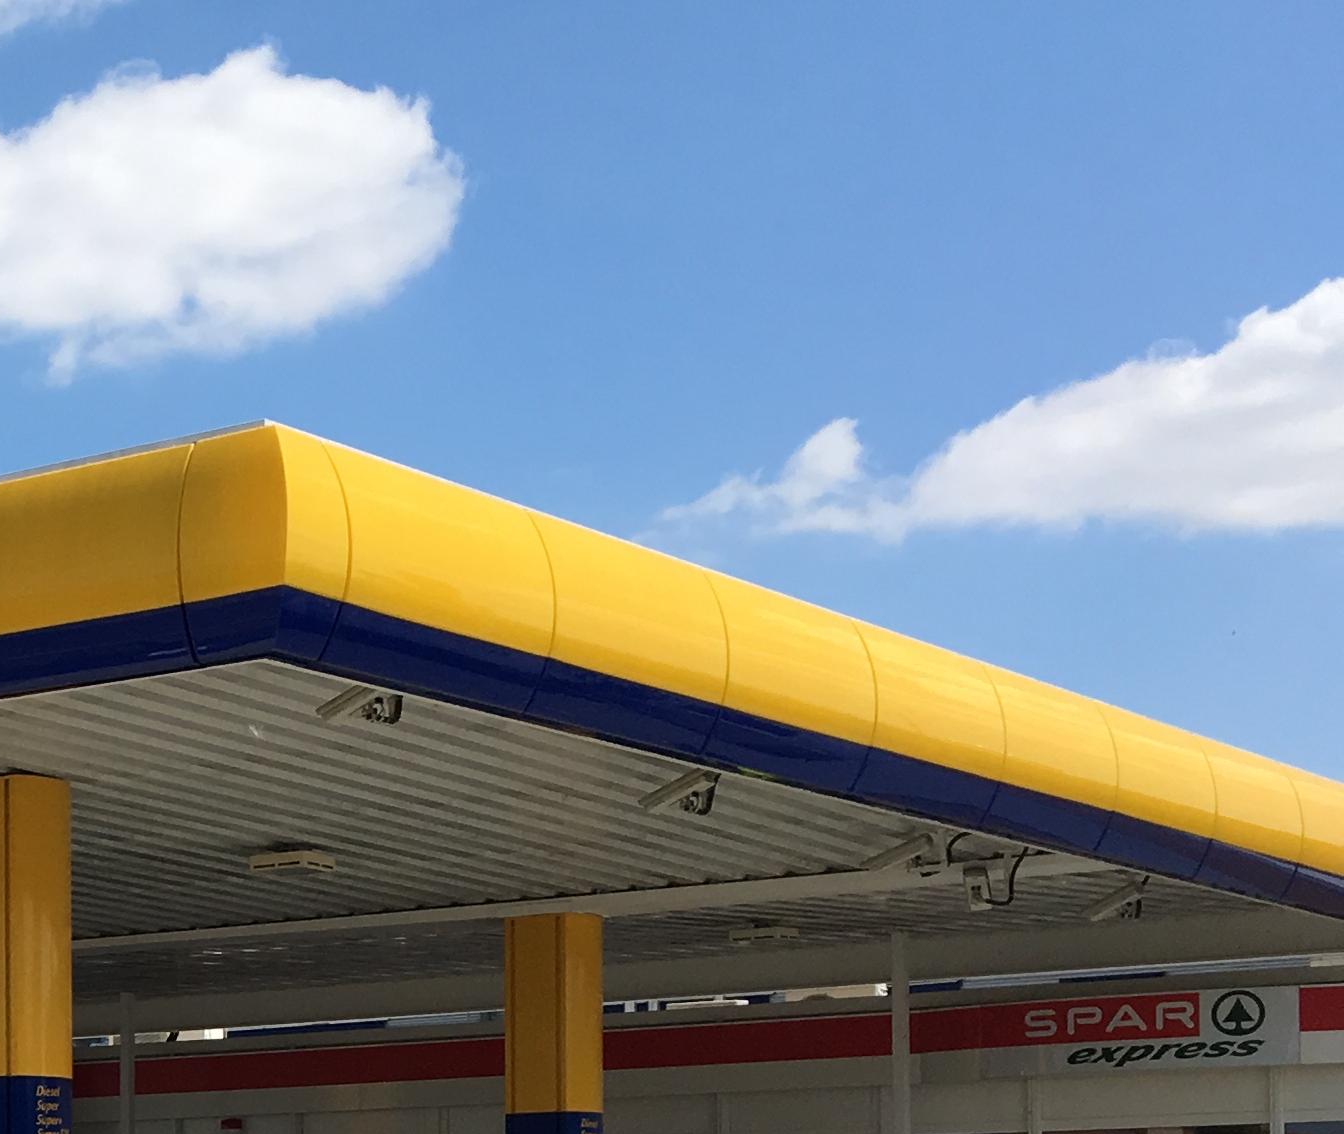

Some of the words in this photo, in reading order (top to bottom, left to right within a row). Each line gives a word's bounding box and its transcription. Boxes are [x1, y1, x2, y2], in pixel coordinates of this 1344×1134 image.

[1024, 1001, 1196, 1038] SPAR
[1067, 1039, 1266, 1067] express
[35, 1099, 60, 1114] Super
